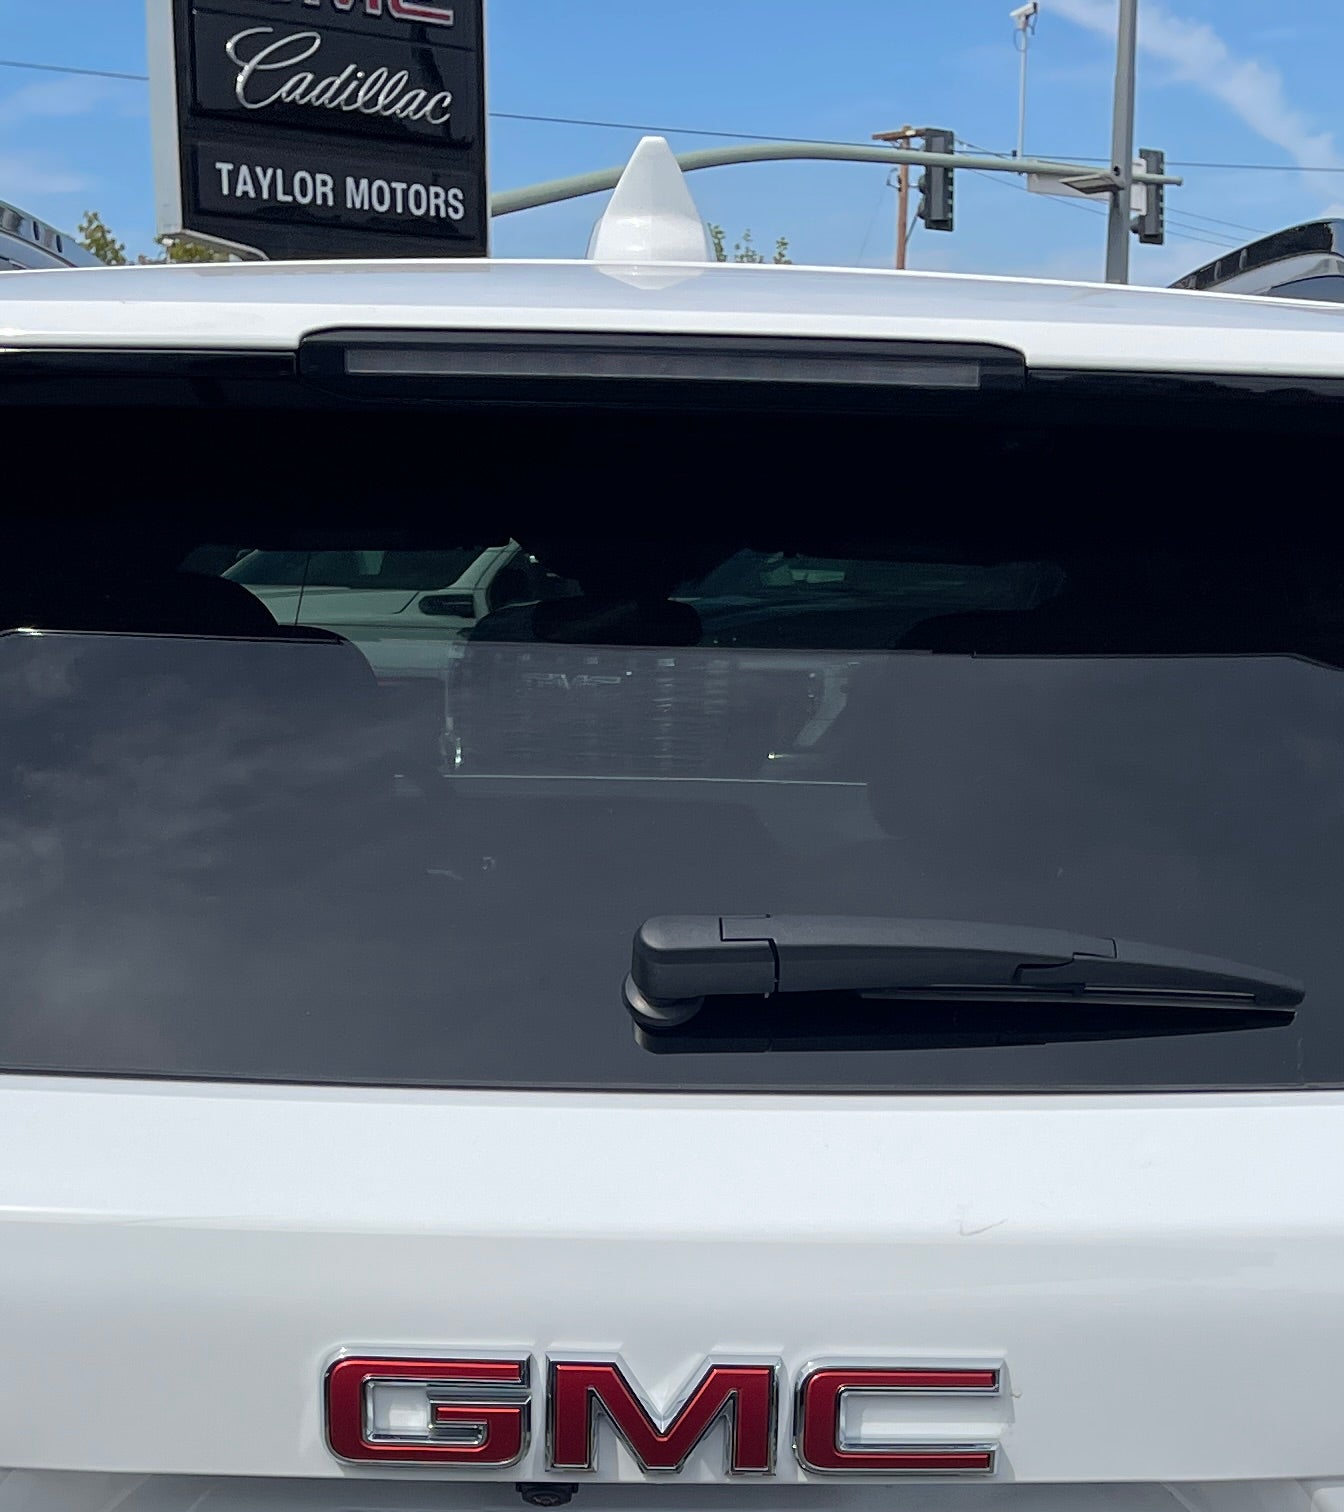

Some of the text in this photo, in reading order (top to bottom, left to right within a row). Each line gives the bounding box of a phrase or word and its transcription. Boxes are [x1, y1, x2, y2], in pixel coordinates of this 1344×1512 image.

[225, 26, 452, 125] Cadillac
[215, 161, 465, 221] TAYLOR MOTORS
[324, 1346, 1005, 1477] GMC
